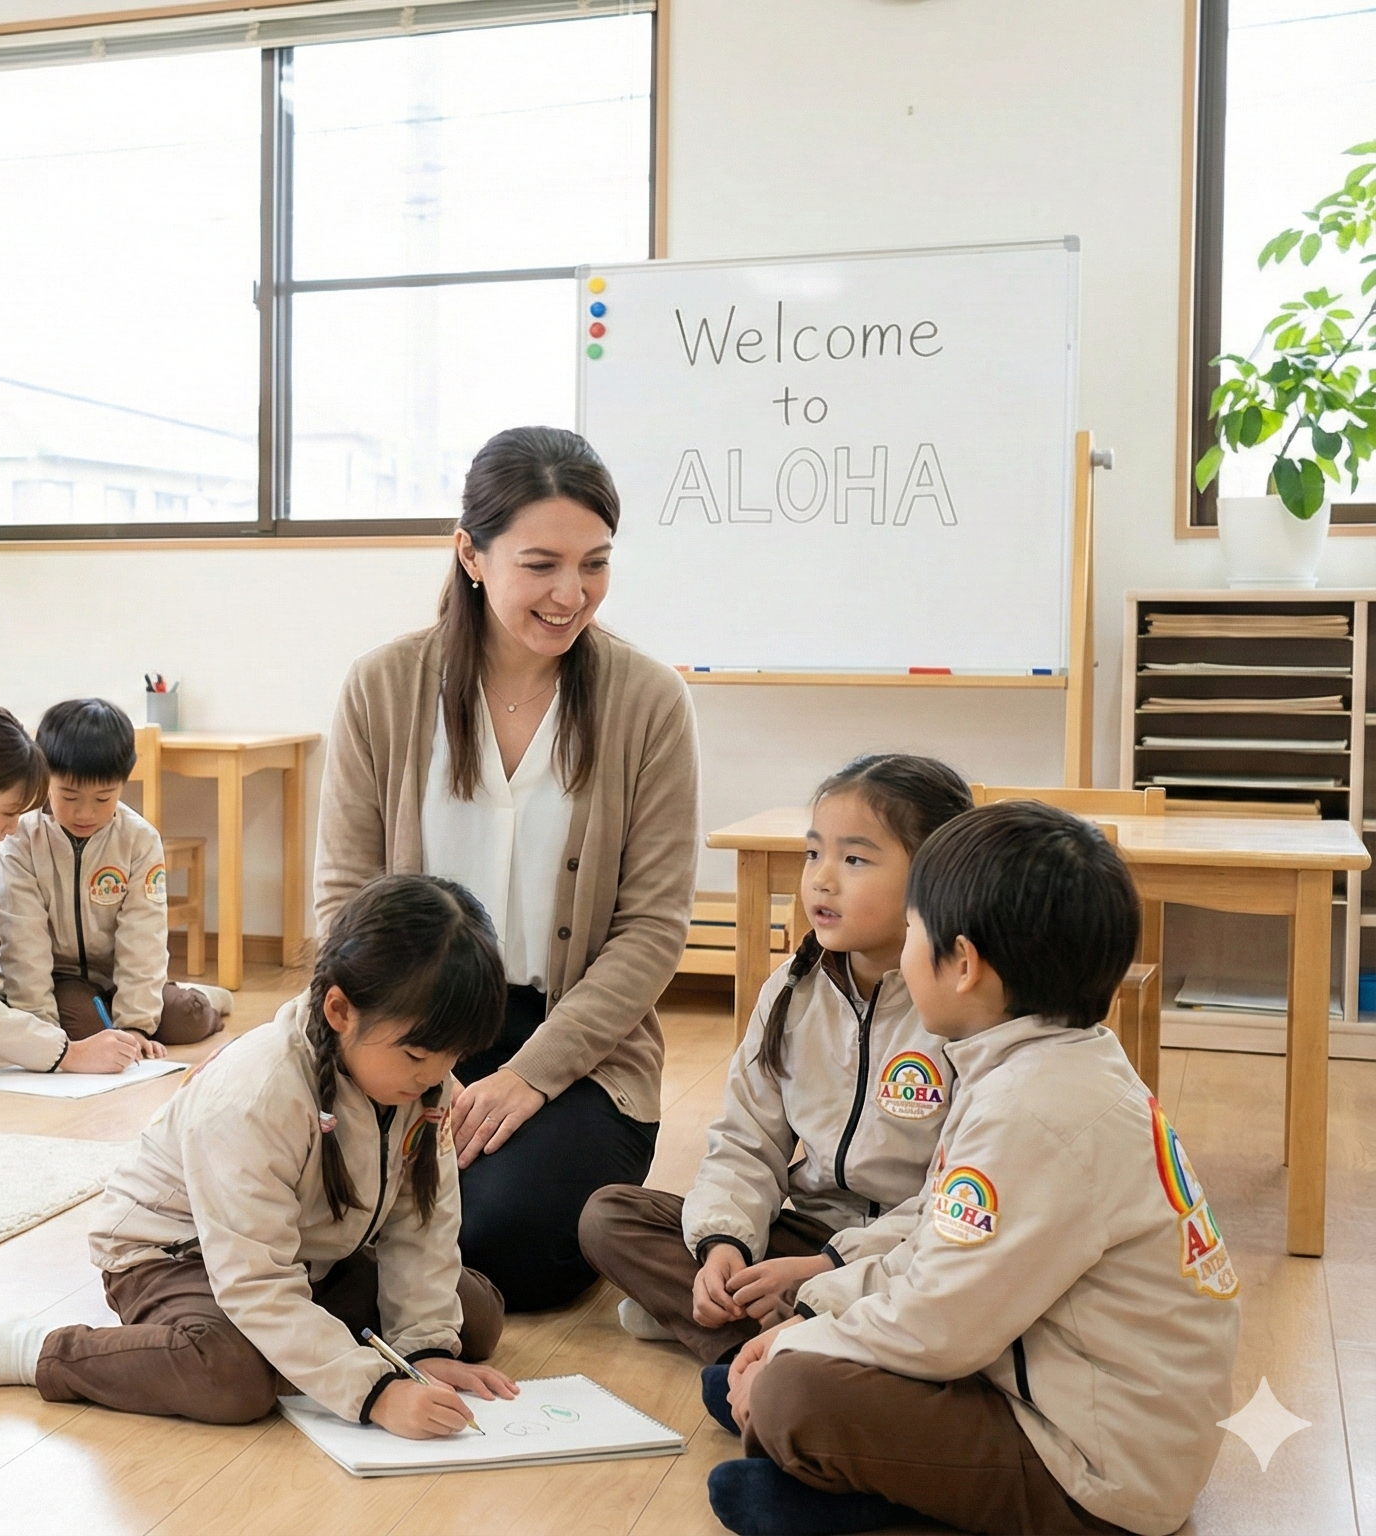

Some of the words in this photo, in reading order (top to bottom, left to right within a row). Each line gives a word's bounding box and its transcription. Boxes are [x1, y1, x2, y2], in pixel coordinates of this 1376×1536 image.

[675, 300, 943, 366] Welcome
[772, 386, 828, 426] to
[658, 443, 958, 526] ALOHA
